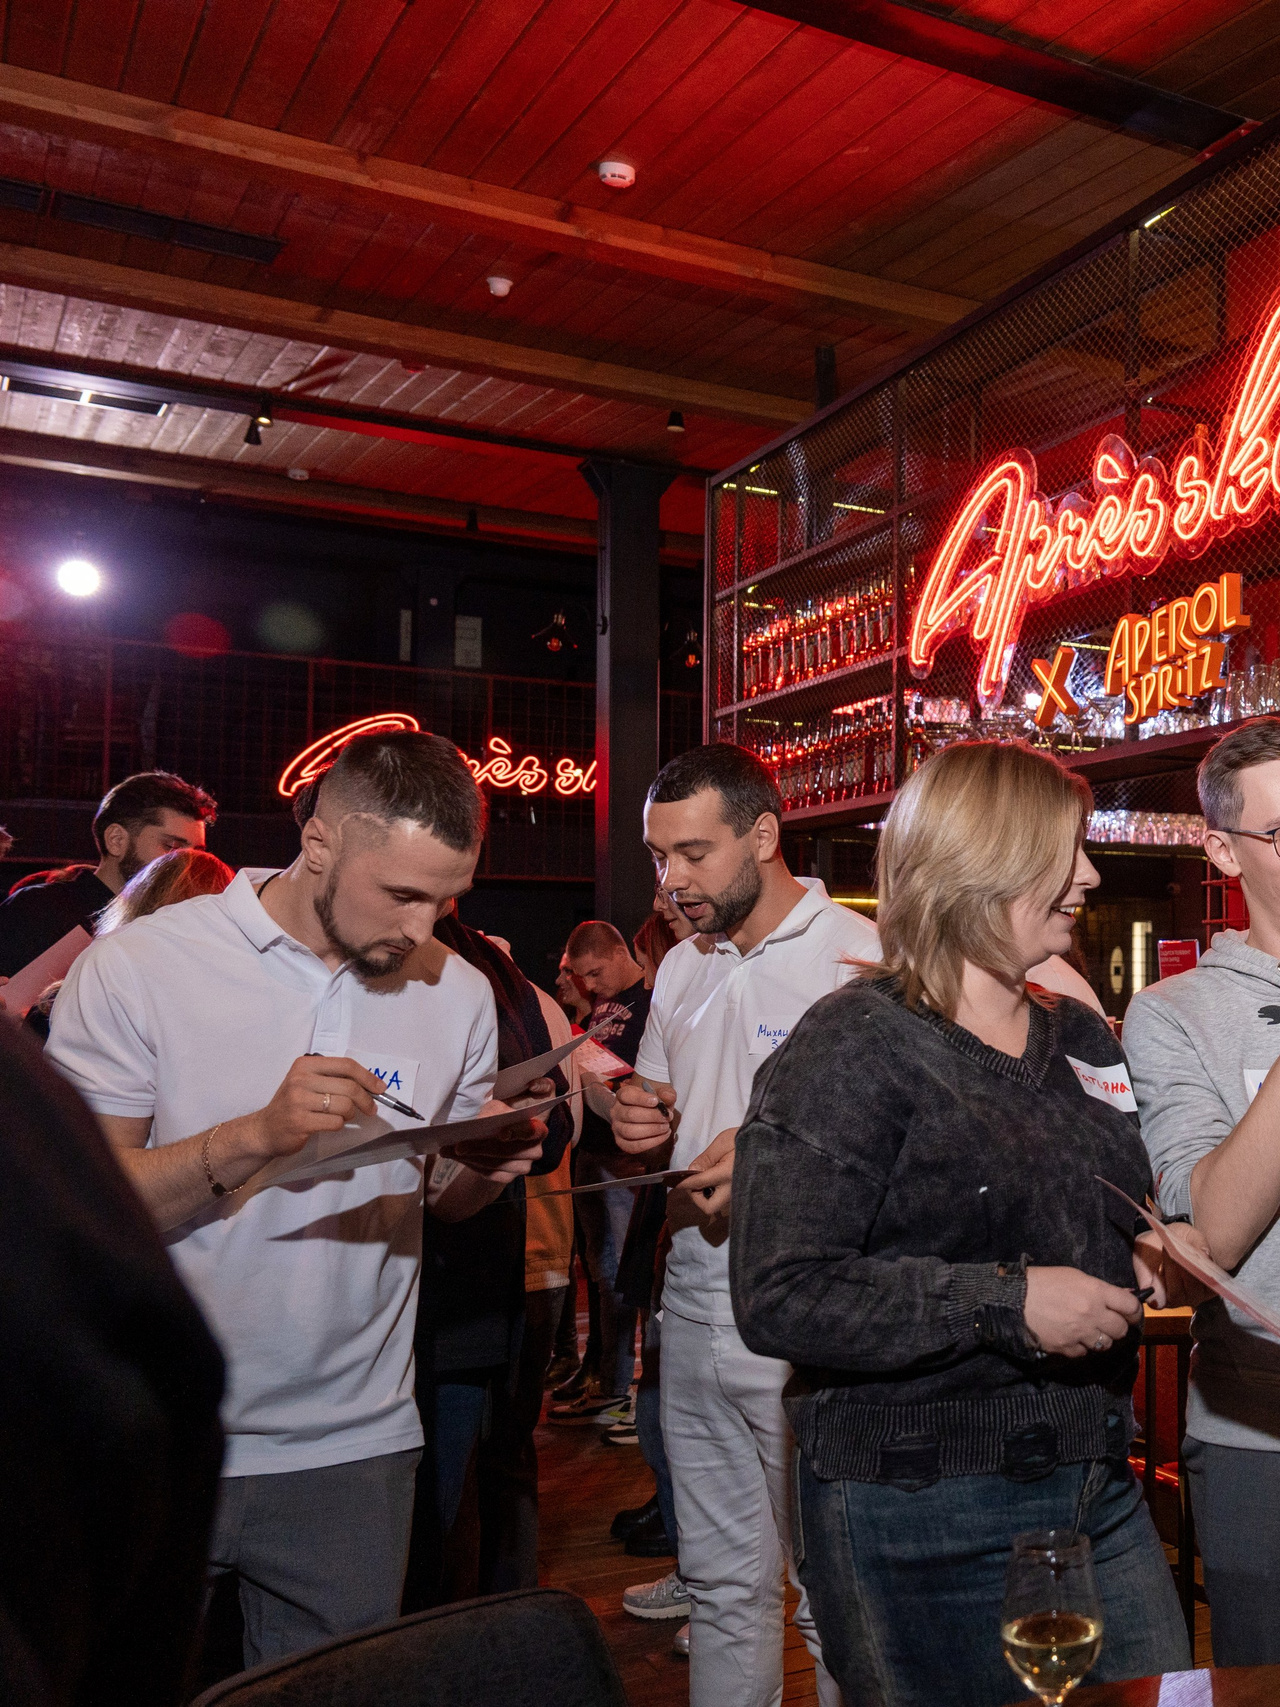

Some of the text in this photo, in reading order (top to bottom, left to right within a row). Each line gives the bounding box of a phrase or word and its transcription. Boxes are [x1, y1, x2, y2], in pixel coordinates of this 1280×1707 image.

[911, 453, 1167, 696] Après
[1104, 572, 1250, 696] APEROL
[757, 1024, 789, 1038] Михаи
